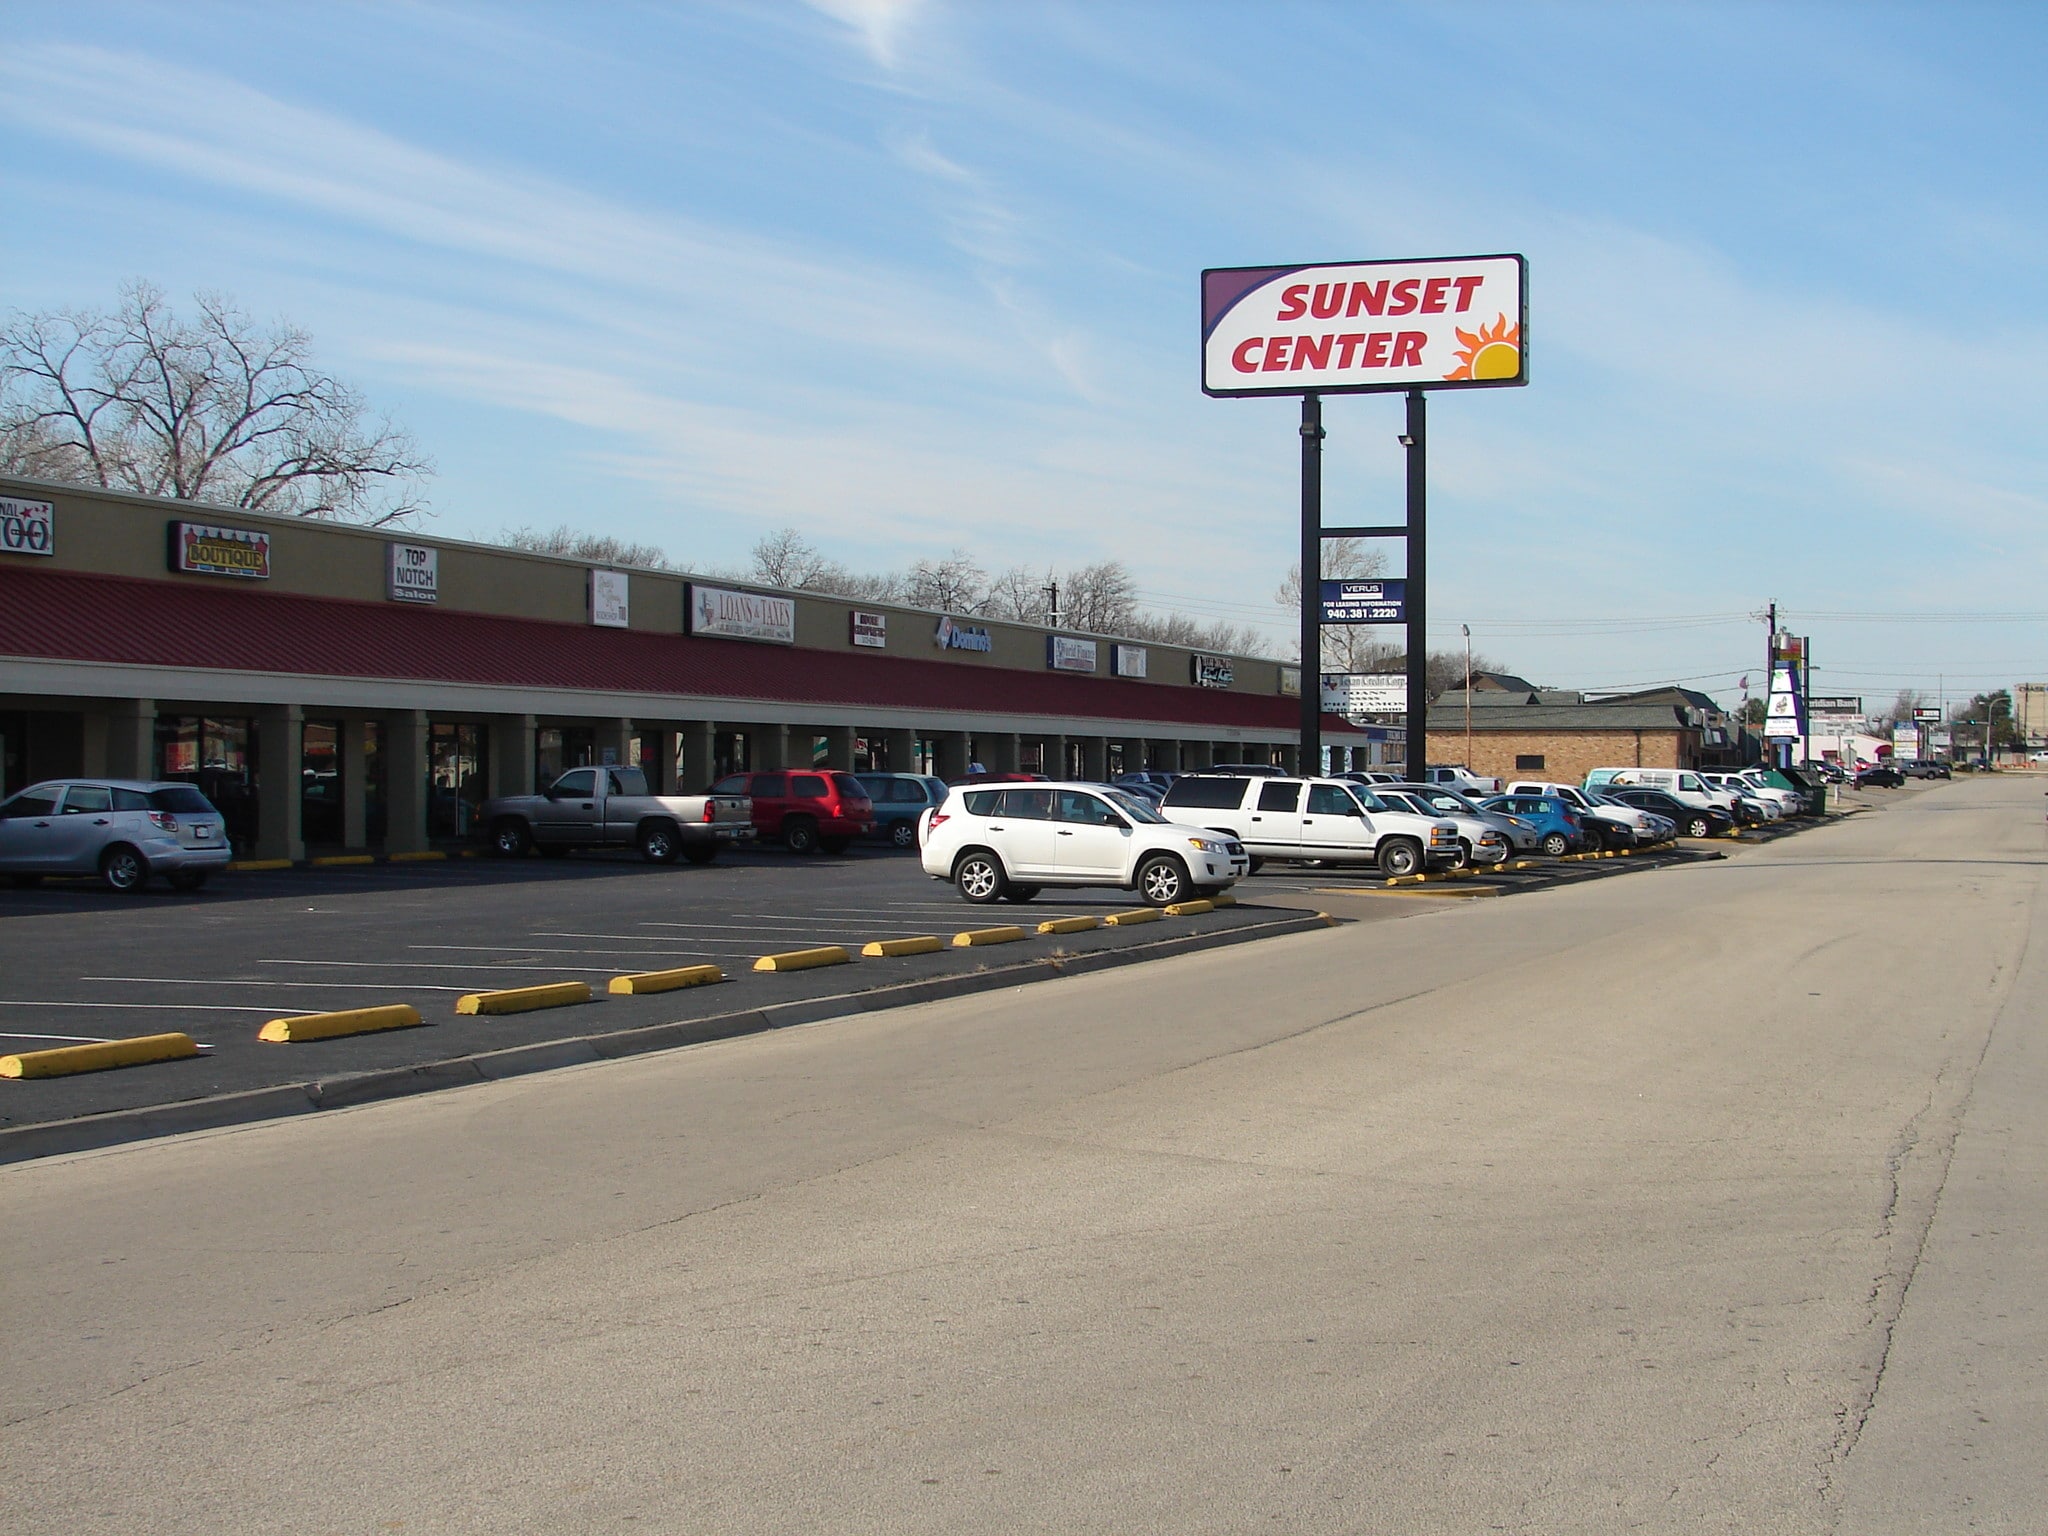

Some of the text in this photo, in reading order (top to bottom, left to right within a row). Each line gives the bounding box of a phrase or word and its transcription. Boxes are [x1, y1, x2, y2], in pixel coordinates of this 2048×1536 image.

[1277, 276, 1483, 320] SUNSET
[1231, 331, 1427, 373] CENTER
[190, 545, 264, 567] BOUTIQUE
[405, 548, 427, 567] TOP
[396, 566, 433, 587] NOTCH
[394, 588, 436, 600] Salon
[719, 594, 753, 624] LOANS
[760, 599, 791, 628] TAXES
[1327, 608, 1398, 619] 940.381.2220
[952, 625, 992, 652] Domino's
